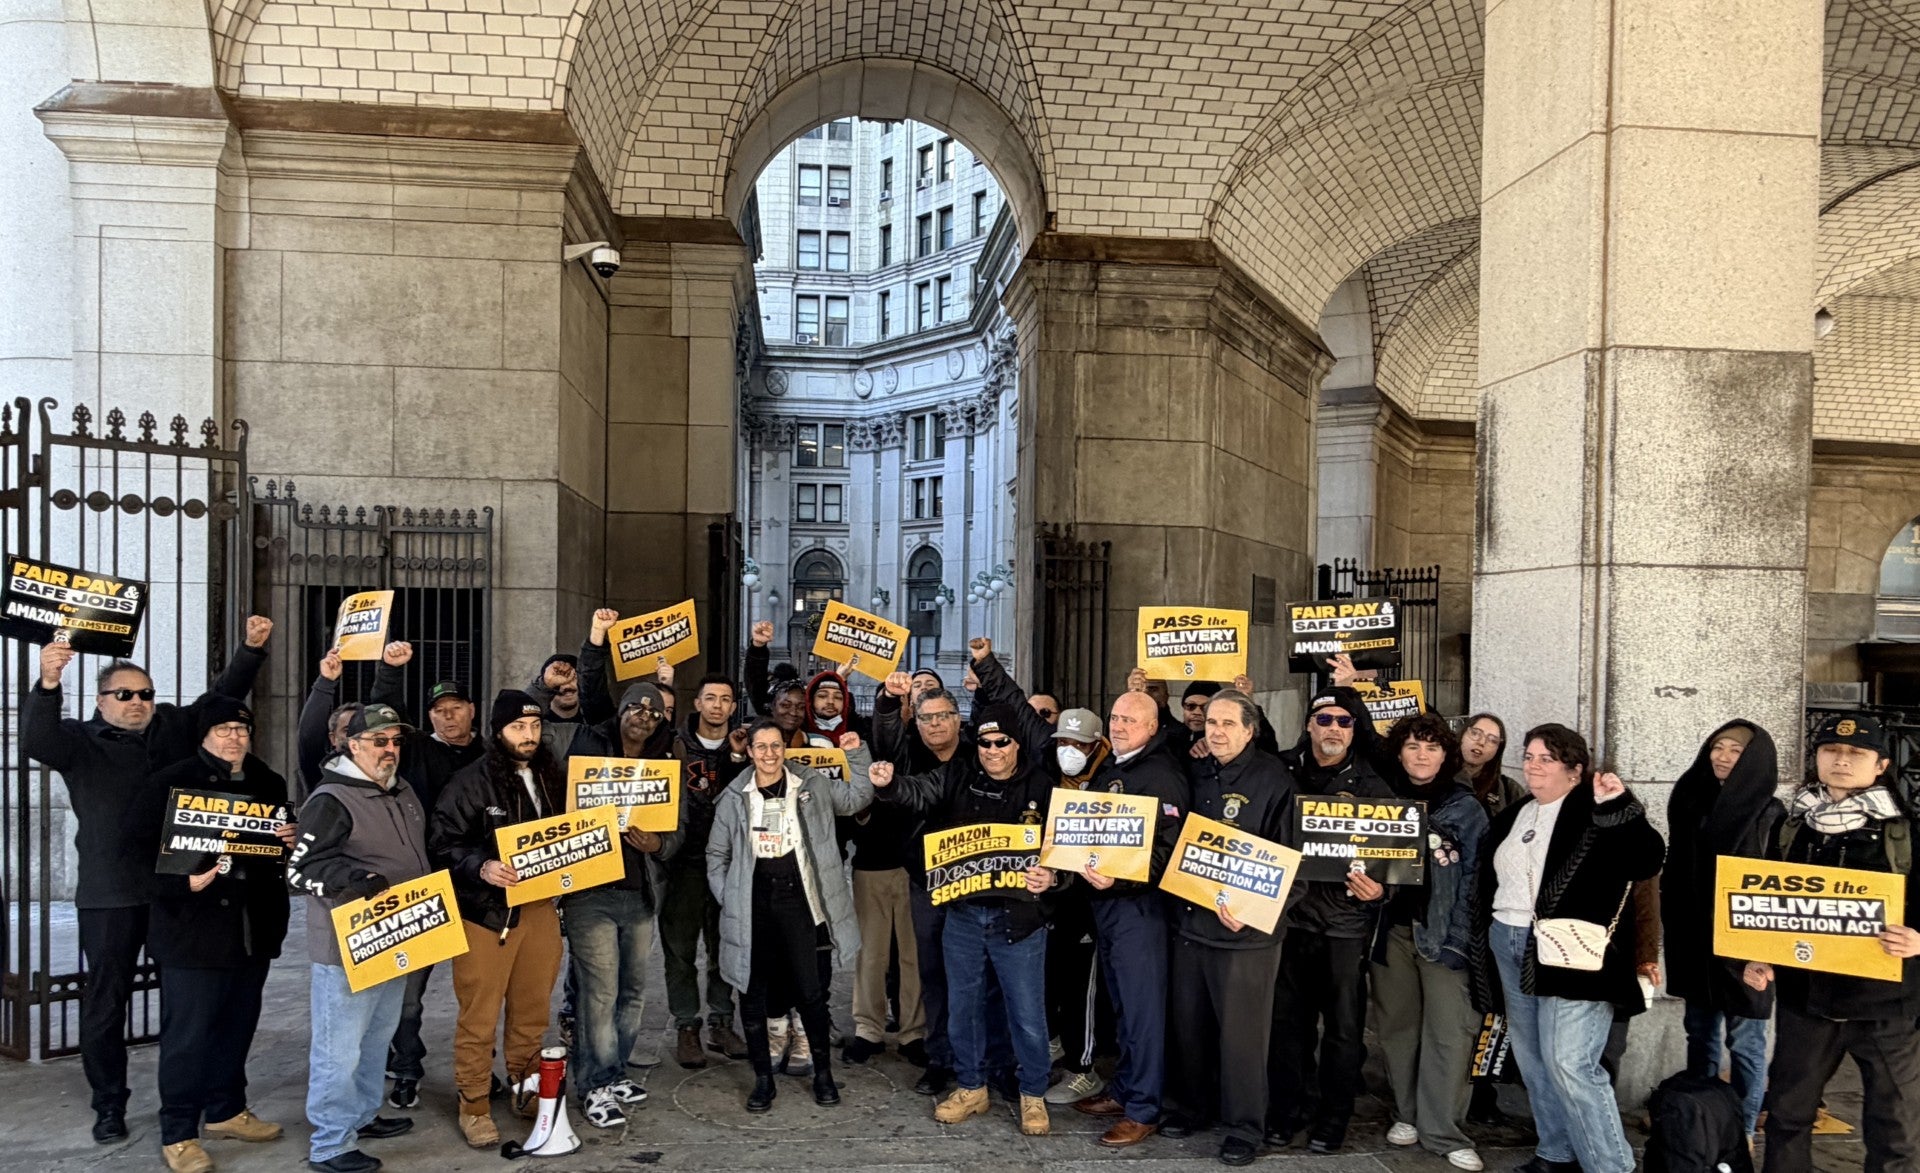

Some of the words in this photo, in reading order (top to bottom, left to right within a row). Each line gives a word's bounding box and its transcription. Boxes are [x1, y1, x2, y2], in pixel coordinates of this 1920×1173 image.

[13, 561, 68, 587] FAIR
[71, 575, 123, 596] PAY
[124, 586, 140, 599] &
[14, 579, 68, 600] SAFE
[71, 594, 134, 612] JOBS
[359, 599, 376, 608] the
[6, 602, 65, 626] AMAZON
[65, 618, 128, 633] TEAMSTERS
[58, 603, 79, 613] for
[1291, 605, 1336, 619] FAIR
[1339, 602, 1379, 617] PAY
[1381, 601, 1394, 614] &
[360, 621, 379, 631] ACT
[622, 616, 664, 639] PASS
[667, 612, 681, 623] the
[836, 612, 876, 630] PASS
[878, 625, 893, 636] the
[1152, 614, 1203, 629] PASS
[1207, 616, 1228, 626] the
[1295, 619, 1339, 631] SAFE
[1342, 616, 1391, 629] JOBS
[619, 618, 688, 653] DELIVERY
[622, 637, 676, 661] PROTECTION
[676, 628, 690, 640] ACT
[828, 622, 896, 650] DELIVERY
[1146, 629, 1235, 646] DELIVERY
[1334, 631, 1351, 639] for
[826, 632, 877, 653] PROTECTION
[877, 647, 893, 659] ACT
[1148, 642, 1212, 657] PROTECTION
[1214, 641, 1236, 652] ACT
[1294, 641, 1342, 654] AMAZON
[1342, 639, 1393, 650] TEAMSTERS
[1358, 687, 1396, 699] PASS
[1398, 687, 1410, 696] the
[1364, 696, 1416, 712] ELIVERY
[1370, 708, 1405, 720] TECTION
[816, 755, 833, 765] the
[584, 766, 636, 780] PASS
[641, 767, 660, 777] the
[577, 779, 668, 796] DELIVERY
[177, 794, 230, 813] FAIR
[232, 801, 275, 818] PAY
[275, 806, 287, 820] &
[578, 794, 645, 807] PROTECTION
[647, 792, 668, 803] ACT
[1064, 801, 1113, 815] PASS
[1116, 803, 1136, 814] the
[1302, 801, 1354, 818] FAIR
[1358, 804, 1404, 820] PAY
[1405, 806, 1420, 821] &
[178, 812, 230, 826] SAFE
[233, 819, 284, 832] JOBS
[1056, 818, 1143, 832] DELIVERY
[1305, 818, 1356, 831] SAFE
[1360, 821, 1416, 834] JOBS
[221, 830, 240, 839] for
[517, 822, 571, 850] PASS
[576, 819, 597, 831] the
[938, 826, 991, 851] AMAZON
[1054, 833, 1118, 845] PROTECTION
[1119, 833, 1142, 845] ACT
[1349, 834, 1369, 843] for
[170, 836, 227, 853] AMAZON
[227, 844, 280, 855] TEAMSTERS
[511, 827, 606, 869] DELIVERY
[934, 837, 1008, 865] TEAMSTERS
[1197, 830, 1254, 856] PASS
[1255, 849, 1278, 863] the
[1302, 842, 1357, 858] AMAZON
[1358, 848, 1415, 858] TEAMSTERS
[516, 850, 587, 881] PROTECTION
[588, 840, 609, 855] ACT
[1184, 845, 1282, 882] DELIVERY
[926, 855, 1040, 891] Deserve
[1181, 860, 1253, 889] PROTECTION
[1253, 880, 1278, 895] ACT
[931, 872, 992, 906] SECURE
[994, 871, 1028, 888] JOB
[1741, 873, 1826, 893] PASS
[1833, 880, 1868, 895] the
[350, 895, 400, 930] PASS
[405, 888, 428, 903] the
[1730, 894, 1882, 919] DELIVERY
[347, 895, 440, 951] DELIVERY
[1732, 913, 1841, 933] PROTECTION
[1846, 920, 1883, 935] ACT
[352, 923, 421, 963] PROTECTION
[422, 910, 446, 930] ACT
